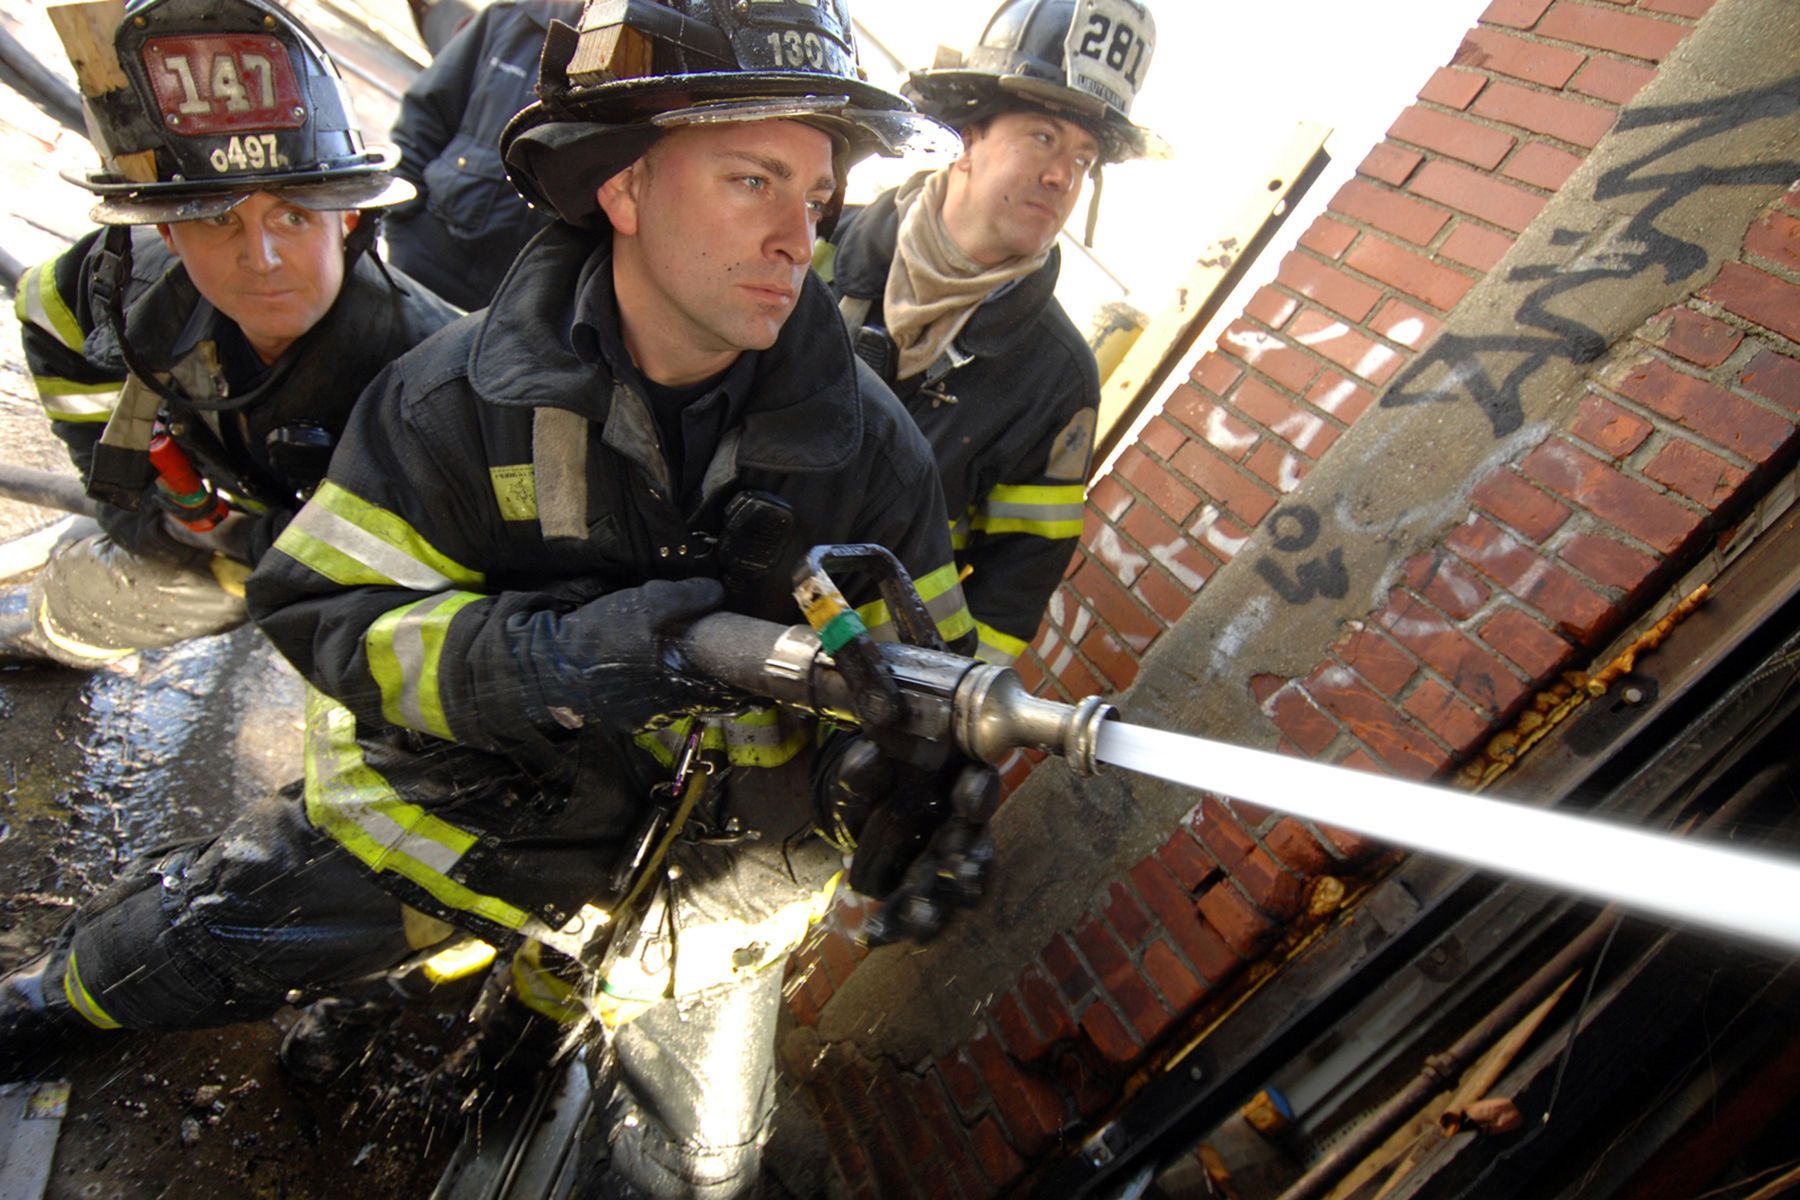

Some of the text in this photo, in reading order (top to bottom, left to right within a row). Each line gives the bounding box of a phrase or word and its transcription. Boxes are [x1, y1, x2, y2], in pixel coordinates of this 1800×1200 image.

[1080, 14, 1146, 87] 281
[165, 53, 275, 114] 147
[209, 133, 279, 173] 0497
